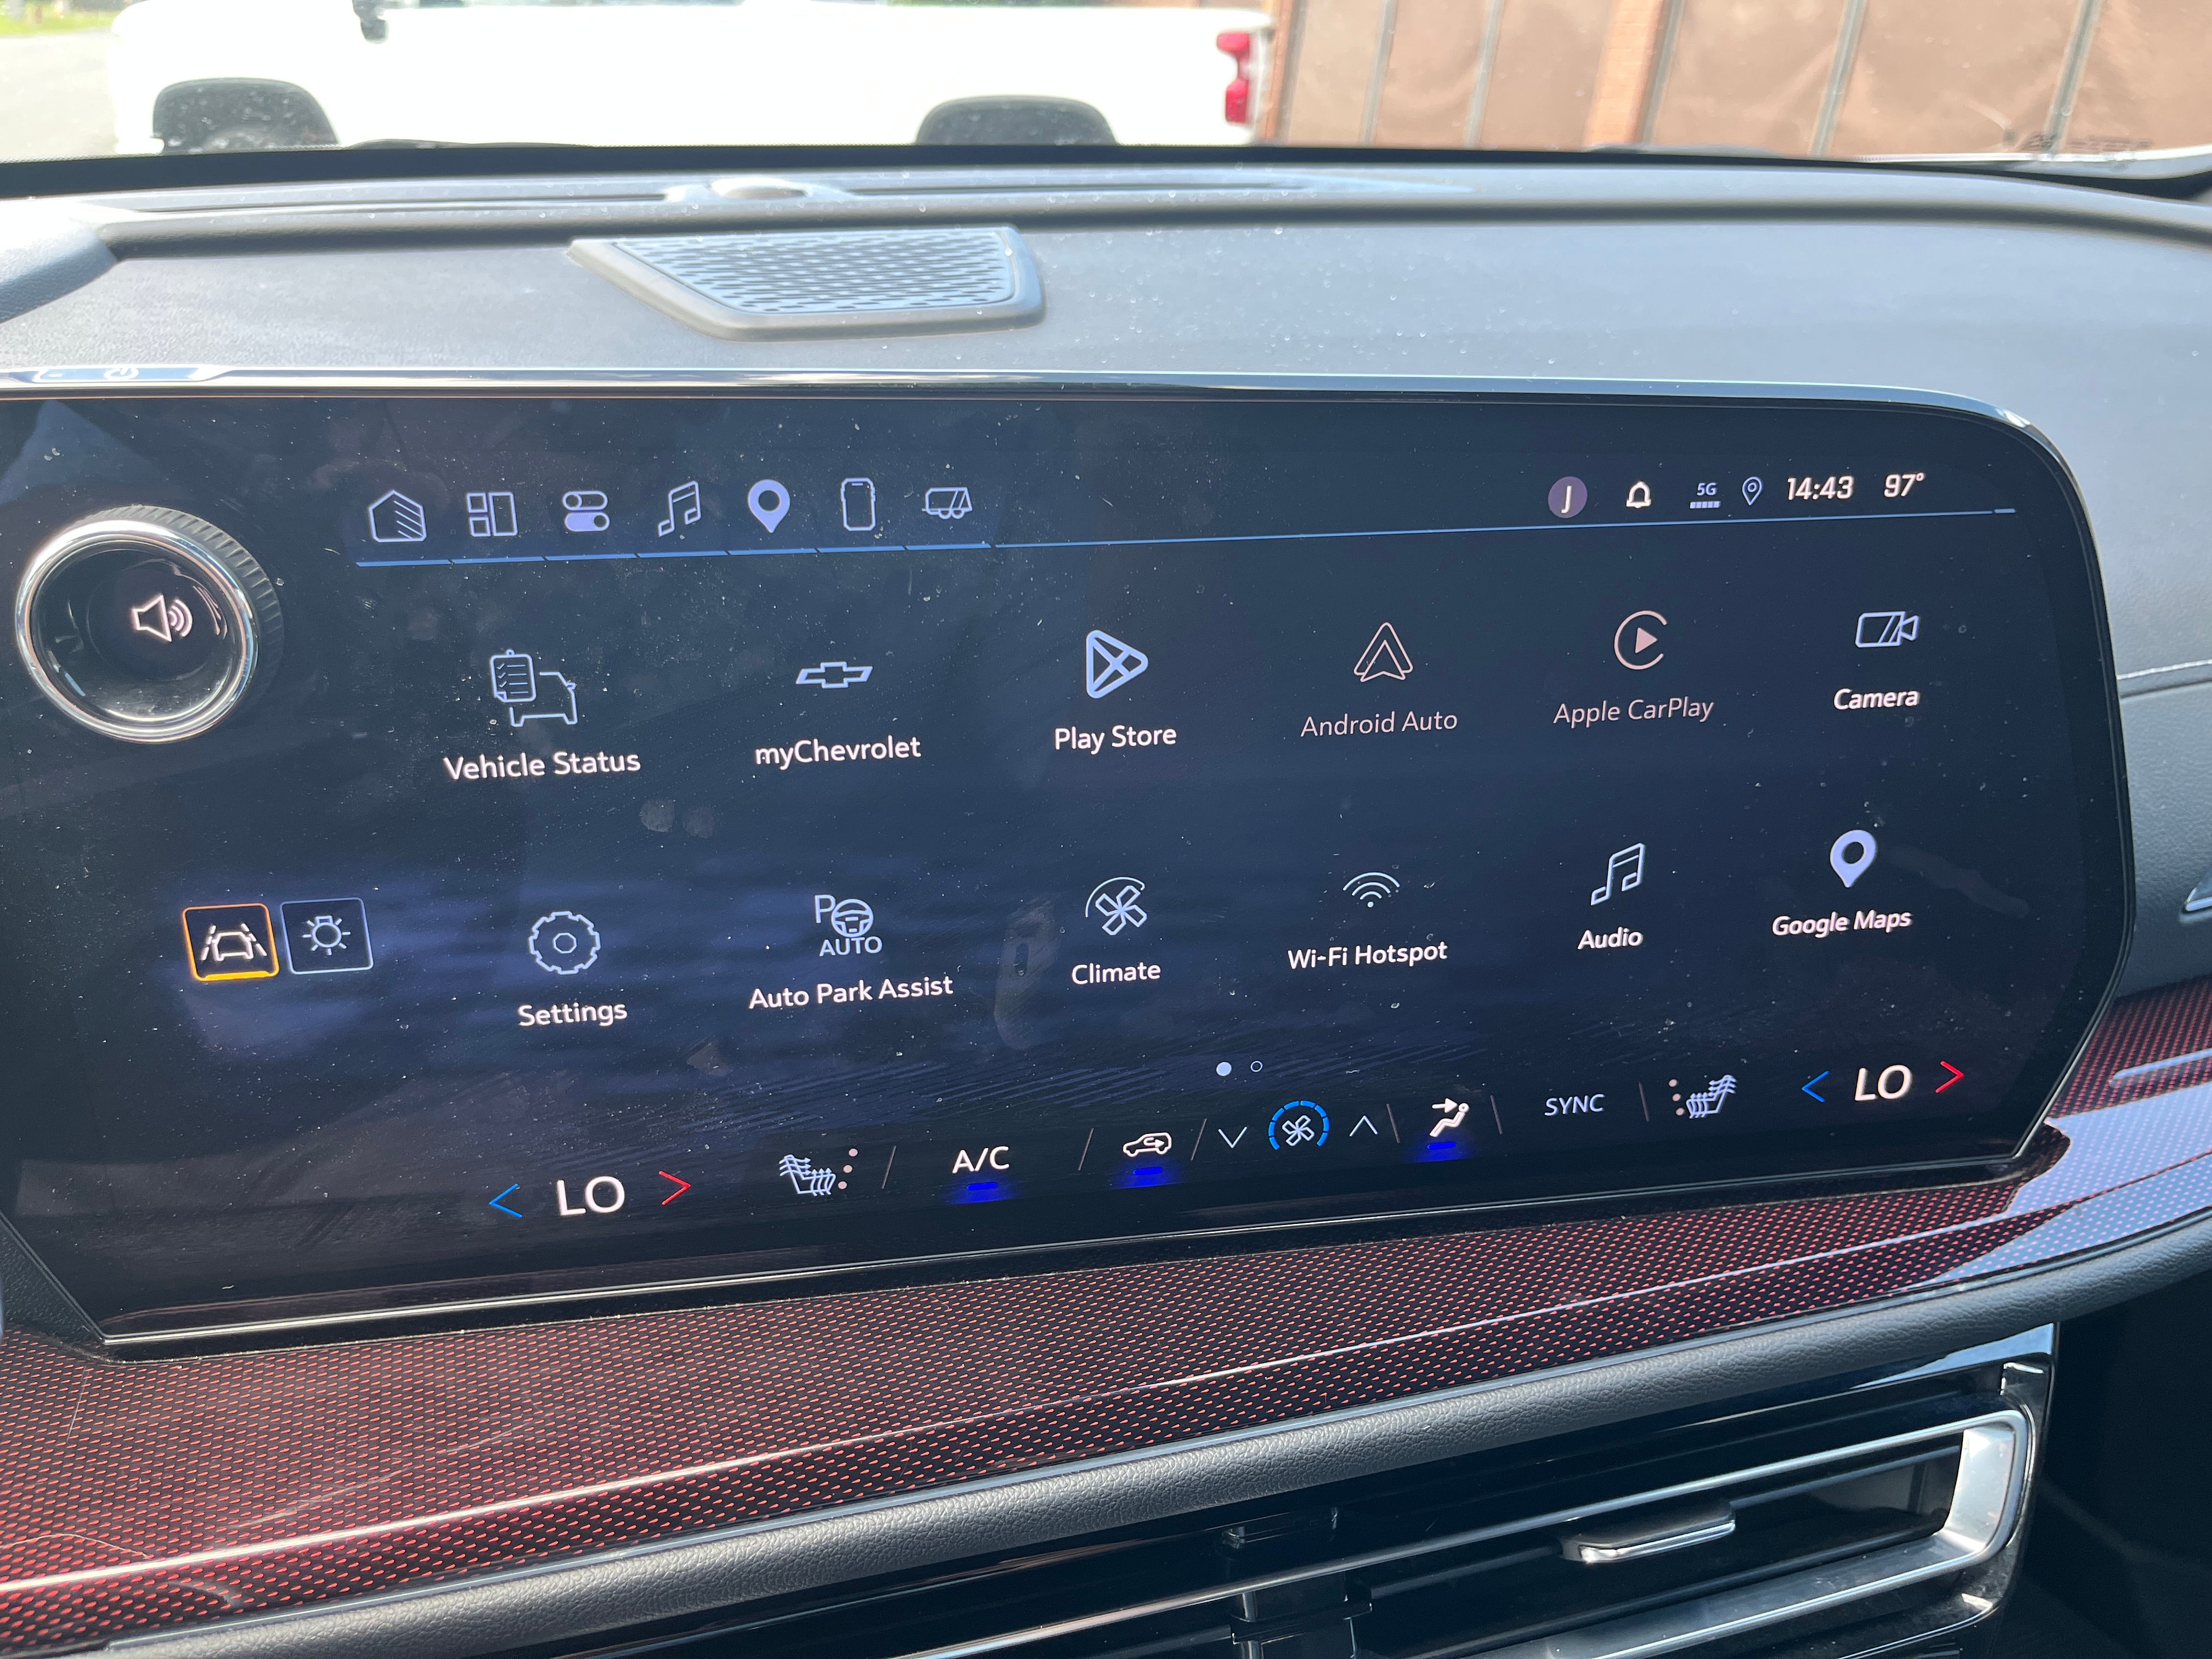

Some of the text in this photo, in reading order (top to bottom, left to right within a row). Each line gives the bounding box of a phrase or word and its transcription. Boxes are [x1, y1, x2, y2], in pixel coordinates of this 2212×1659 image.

[1697, 482, 1717, 496] 5G
[1787, 476, 1853, 500] 14:43
[1553, 696, 1714, 729] Apple CarPlay
[1833, 688, 1919, 710] Camera
[1300, 711, 1458, 737] Android Auto
[755, 735, 922, 770] myChevrolet
[1055, 725, 1177, 755] Play Store
[443, 751, 641, 780] Vehicle Status
[815, 894, 832, 923] P
[1772, 910, 1911, 938] Google Maps
[819, 936, 883, 957] AUTO
[1577, 927, 1643, 950] Audio
[1288, 941, 1448, 969] Wi-Fi Hotspot
[1071, 962, 1161, 985] Climate
[749, 976, 953, 1009] Auto Park Assist
[518, 1002, 628, 1026] Settings
[1854, 1064, 1911, 1101] LO
[1544, 1093, 1605, 1116] SYNC
[952, 1146, 1009, 1173] A/C
[556, 1176, 625, 1216] LO
